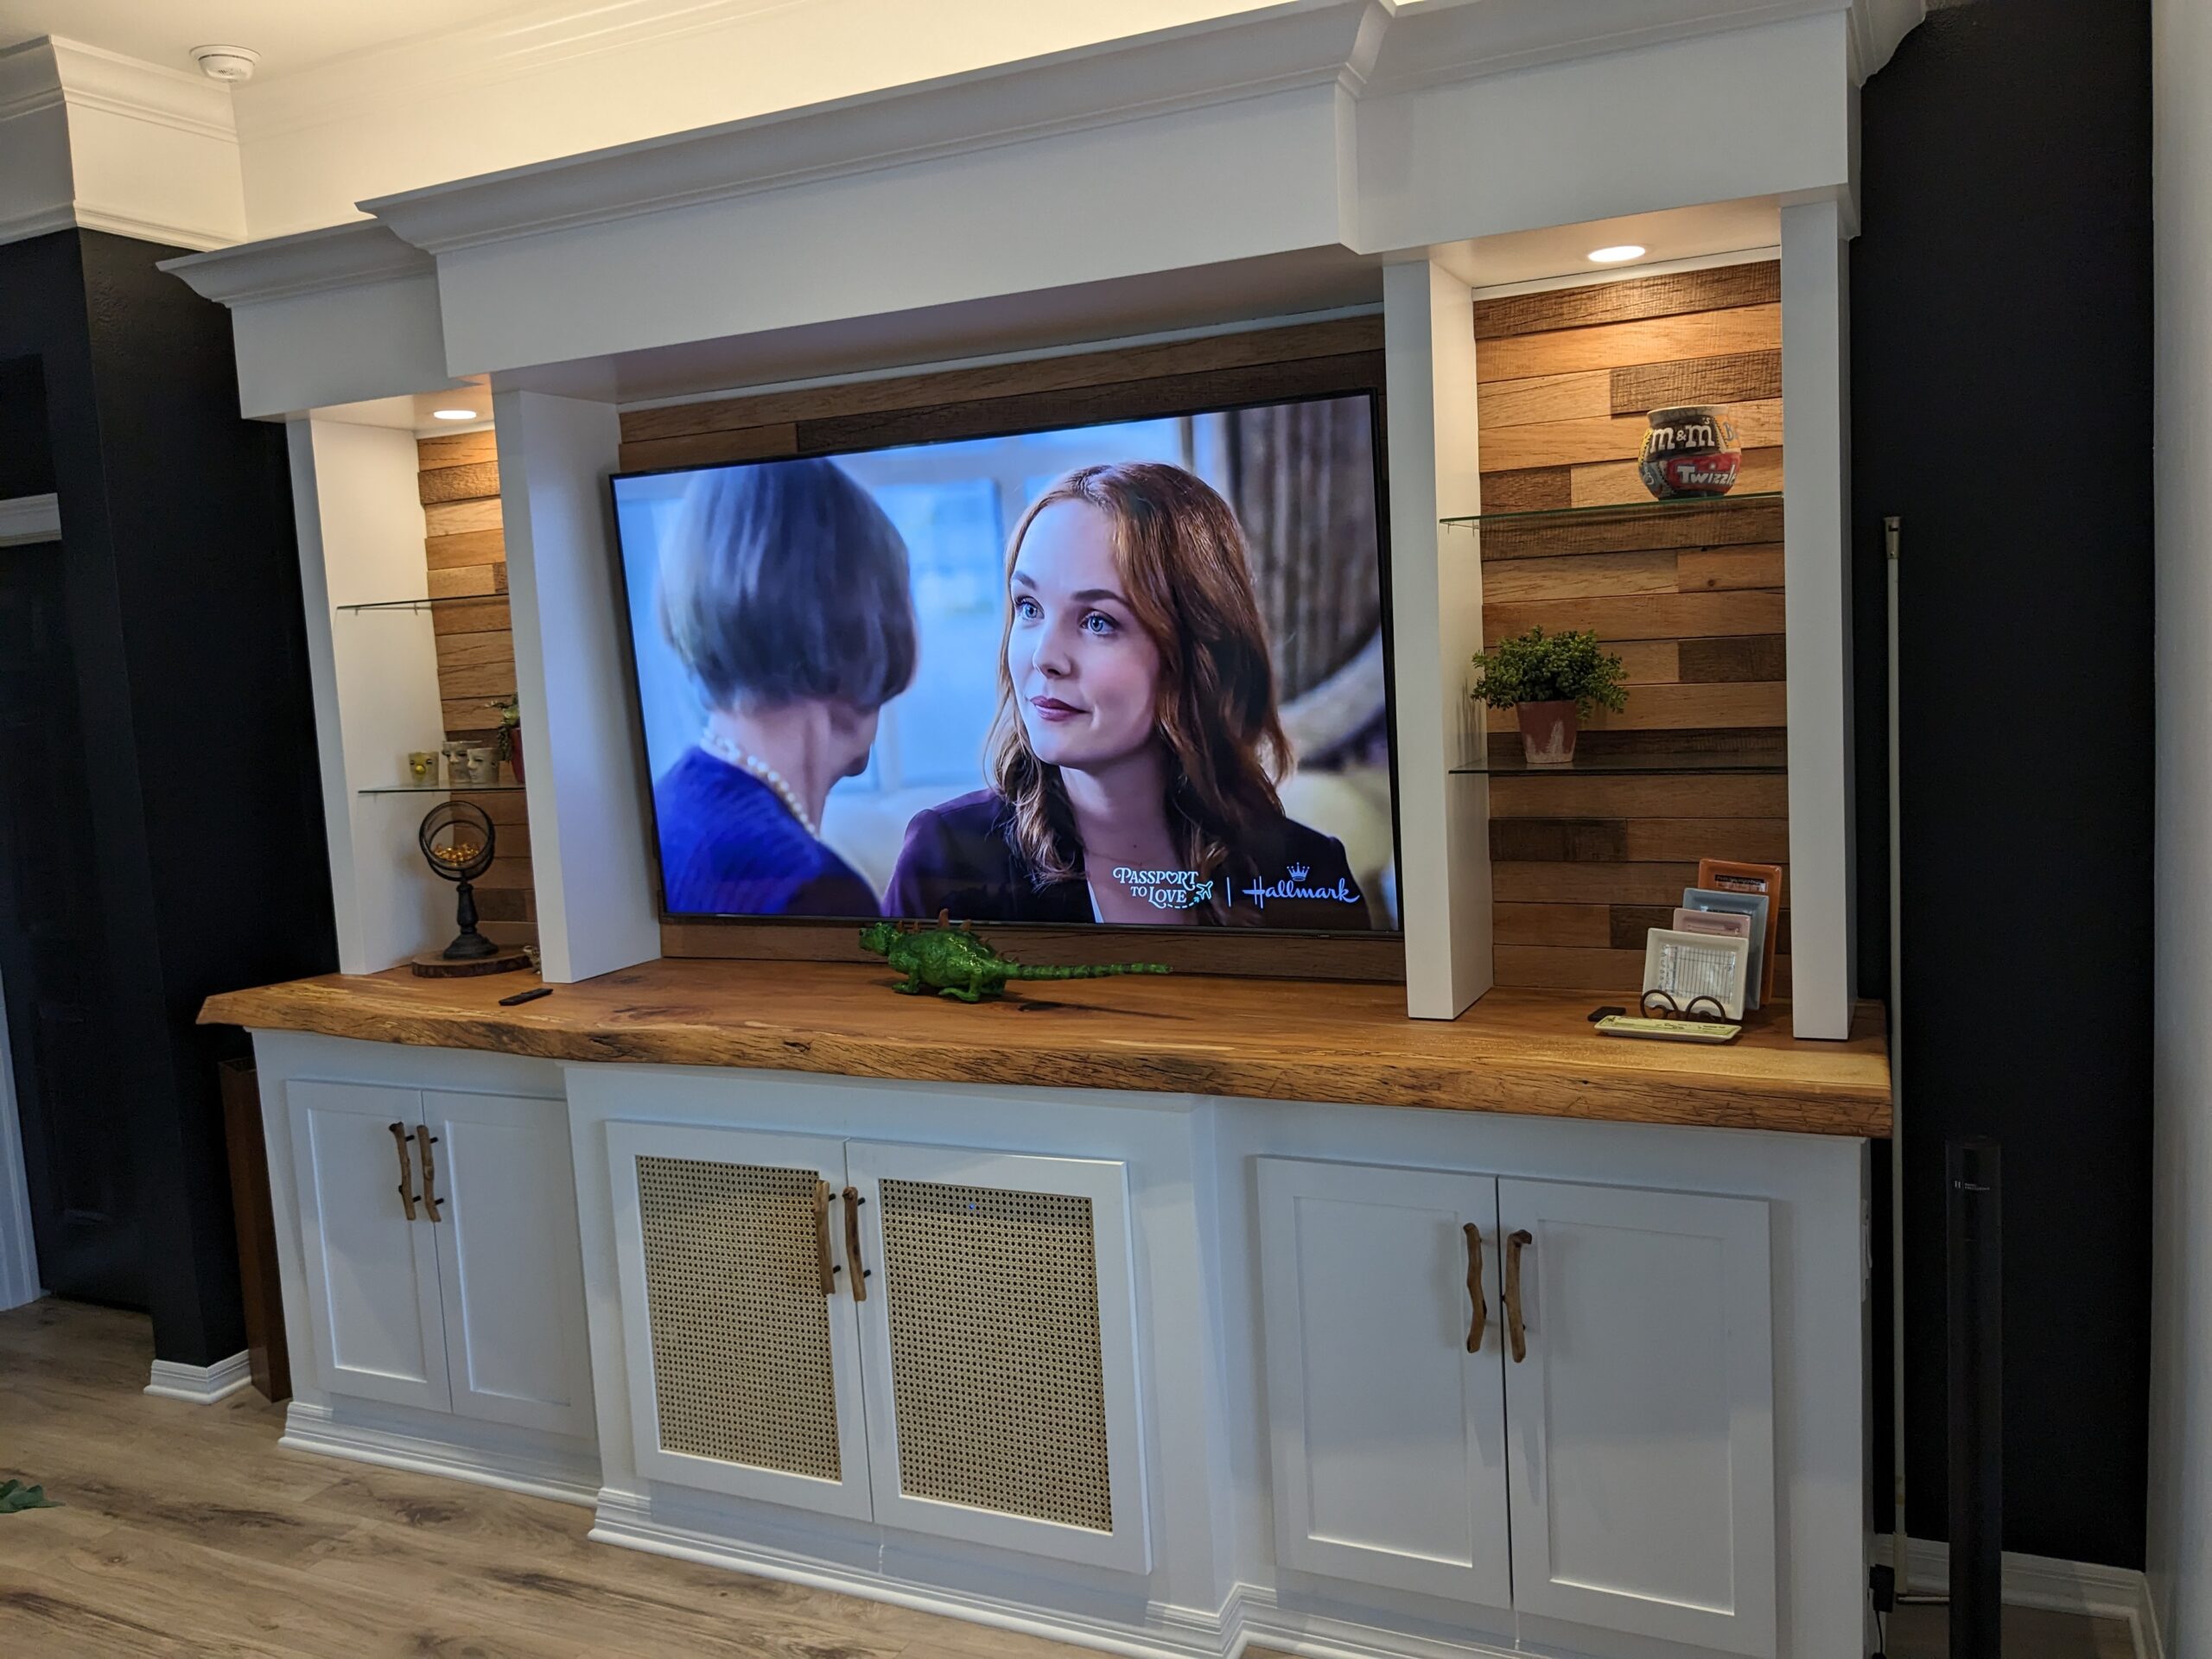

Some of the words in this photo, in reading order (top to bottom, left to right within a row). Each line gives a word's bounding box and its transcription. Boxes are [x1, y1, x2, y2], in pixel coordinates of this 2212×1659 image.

[1130, 886, 1147, 897] TO
[1148, 886, 1187, 909] LOVE
[1242, 876, 1360, 909] Hallmark
